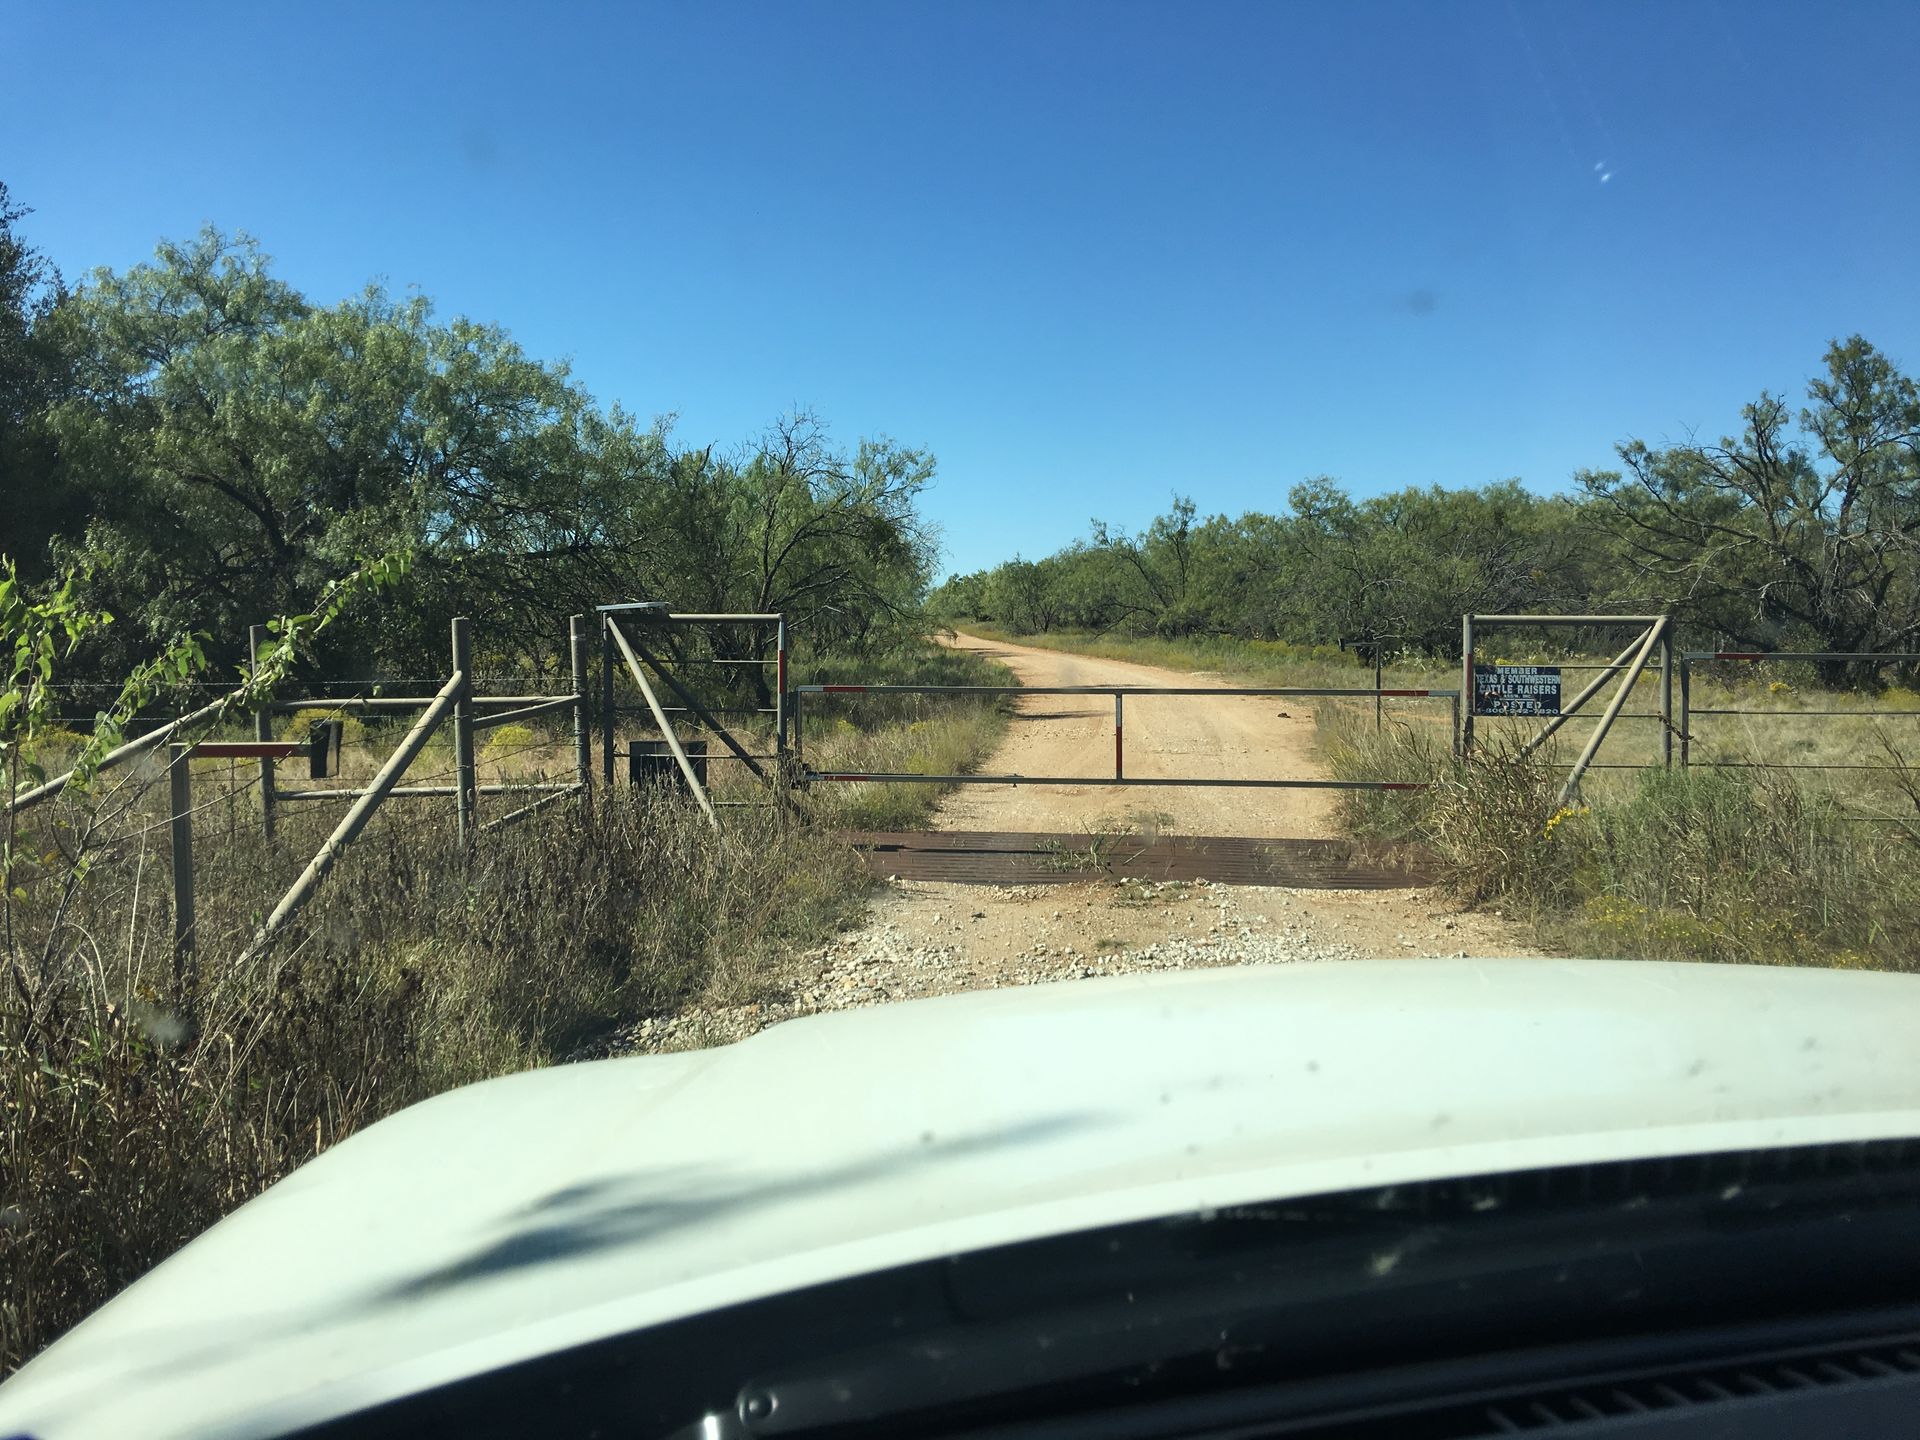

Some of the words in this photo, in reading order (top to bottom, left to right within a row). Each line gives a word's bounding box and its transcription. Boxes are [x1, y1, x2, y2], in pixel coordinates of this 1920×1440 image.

[1476, 675, 1497, 684] TEXAS
[1500, 675, 1506, 684] &
[1508, 675, 1560, 684] SOUTHWESTERN
[1480, 685, 1513, 694] CATTLE
[1518, 685, 1557, 694] RAISERS
